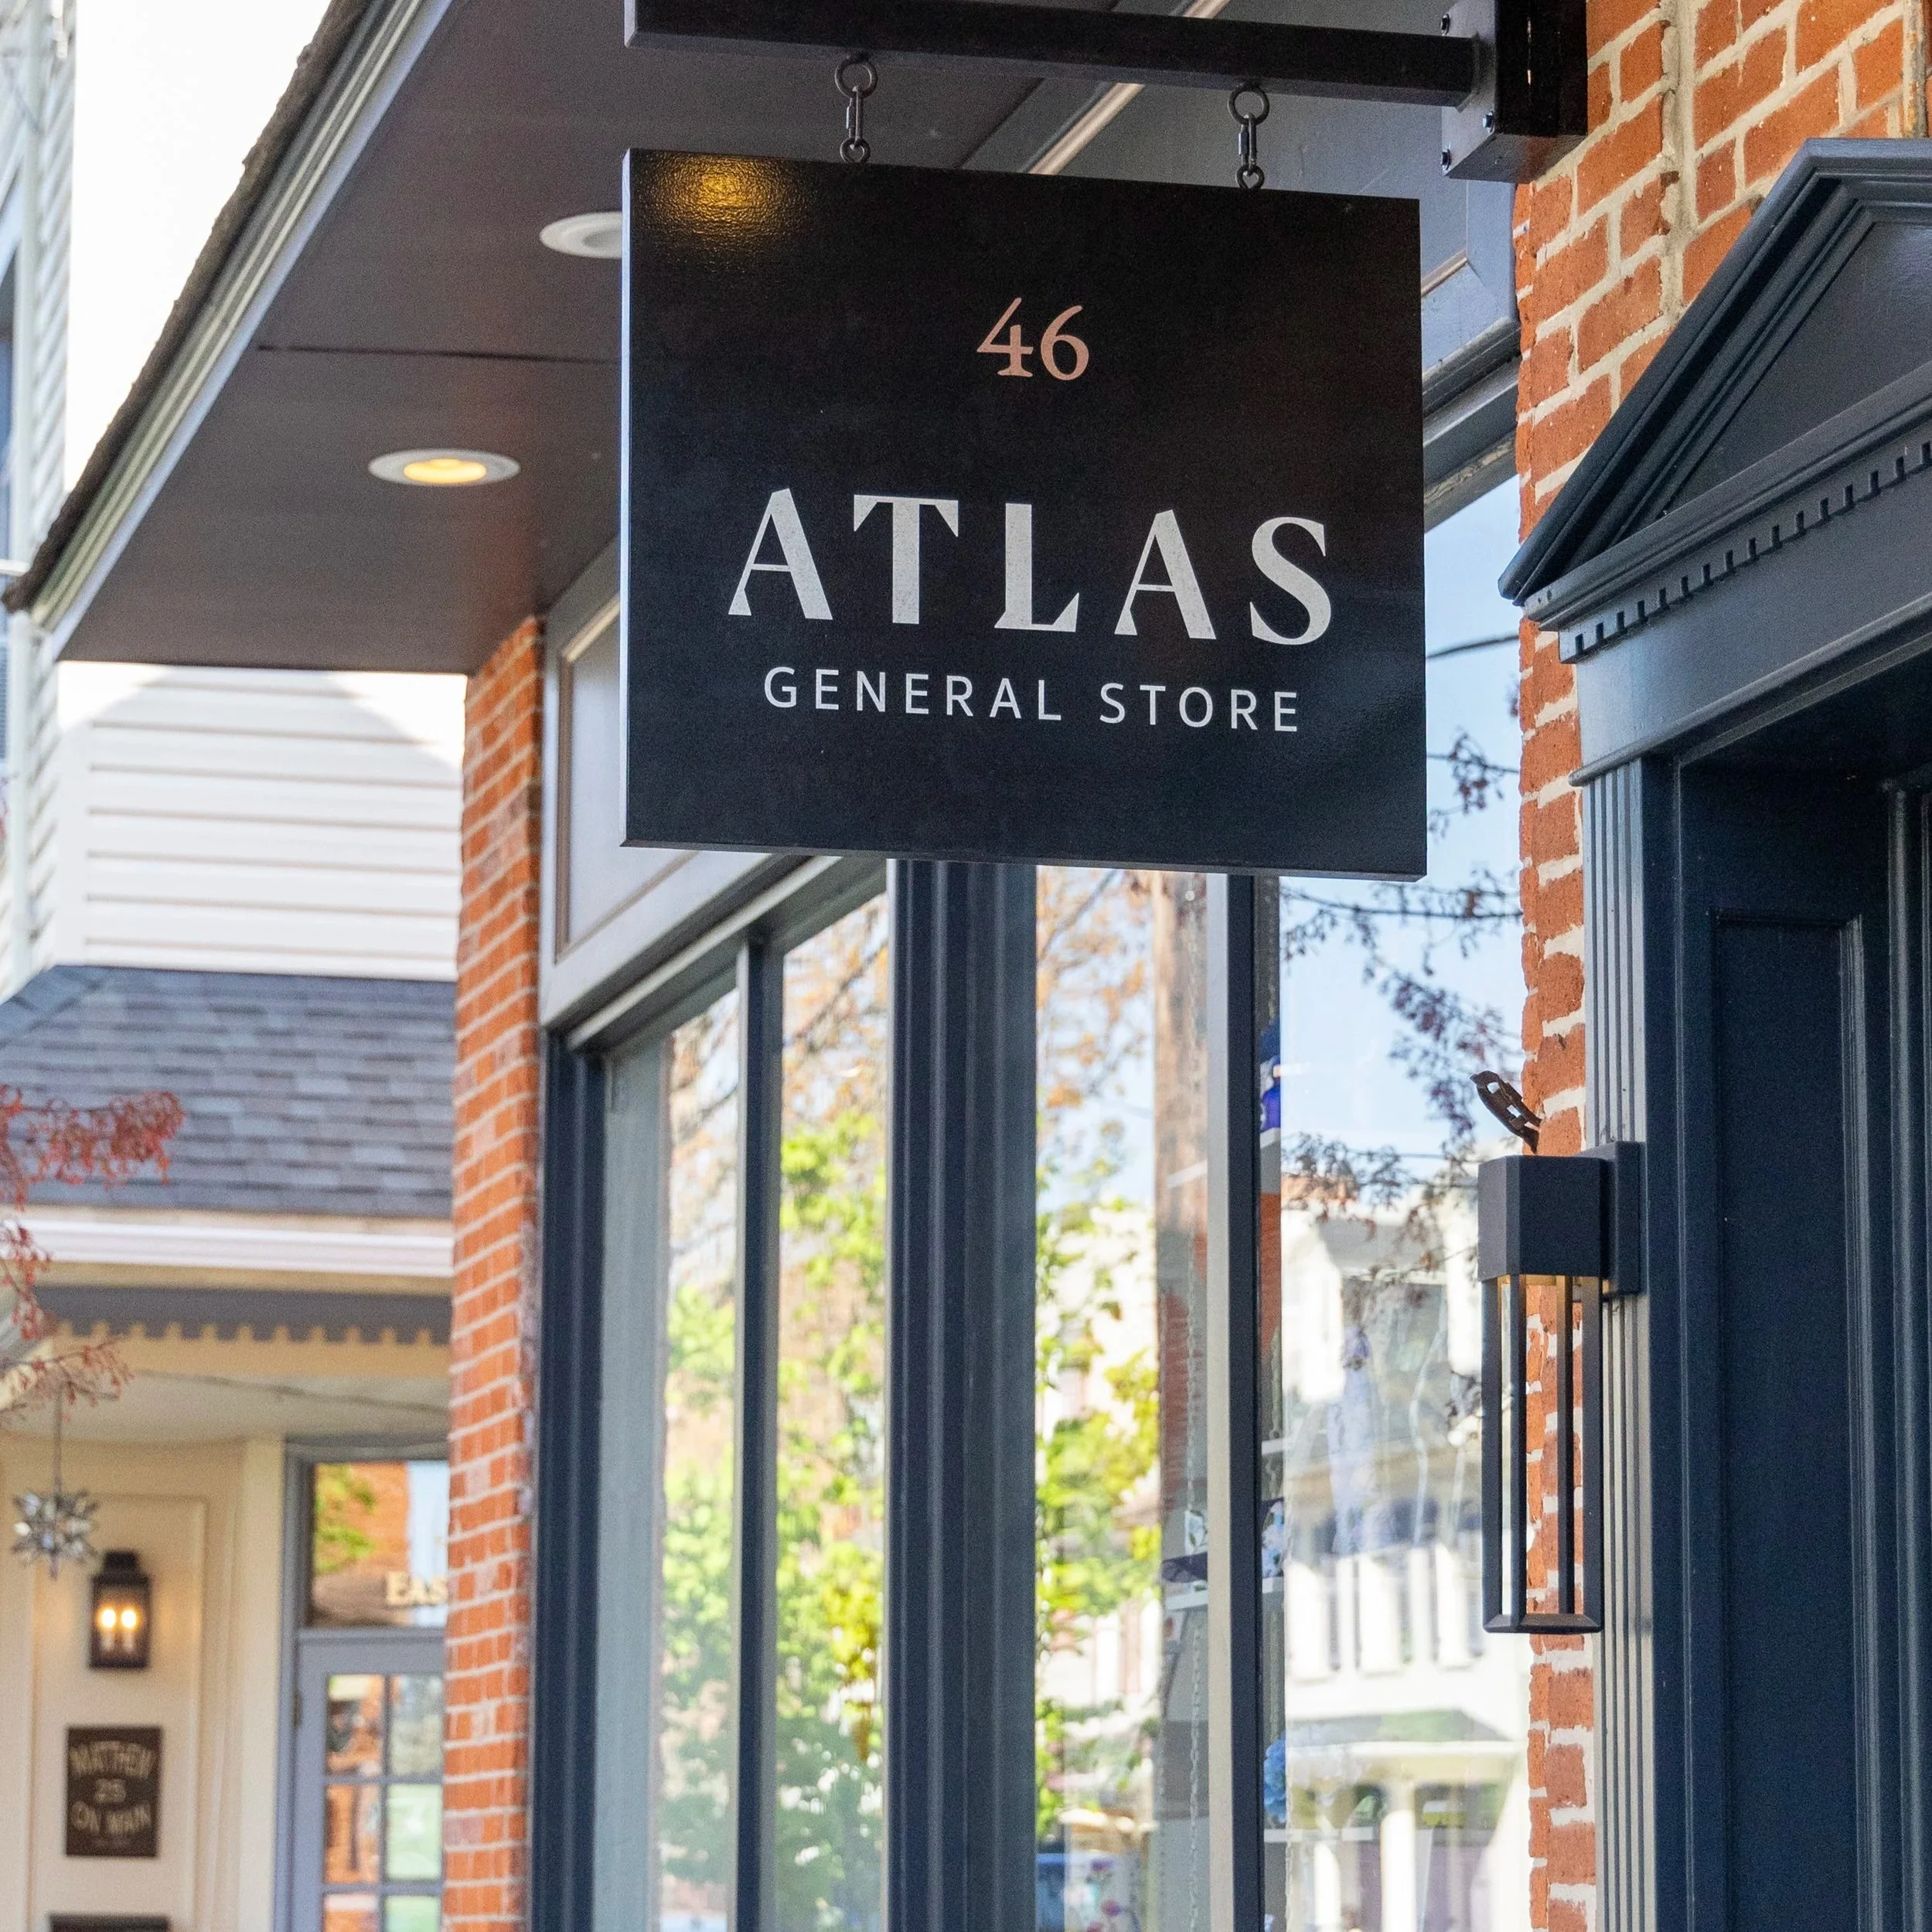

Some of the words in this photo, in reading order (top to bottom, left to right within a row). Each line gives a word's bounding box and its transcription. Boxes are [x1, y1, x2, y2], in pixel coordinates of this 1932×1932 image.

[976, 297, 1089, 380] 46
[727, 488, 1332, 646] ATLAS
[764, 666, 1061, 721] GENERAL
[1099, 682, 1298, 732] STORE
